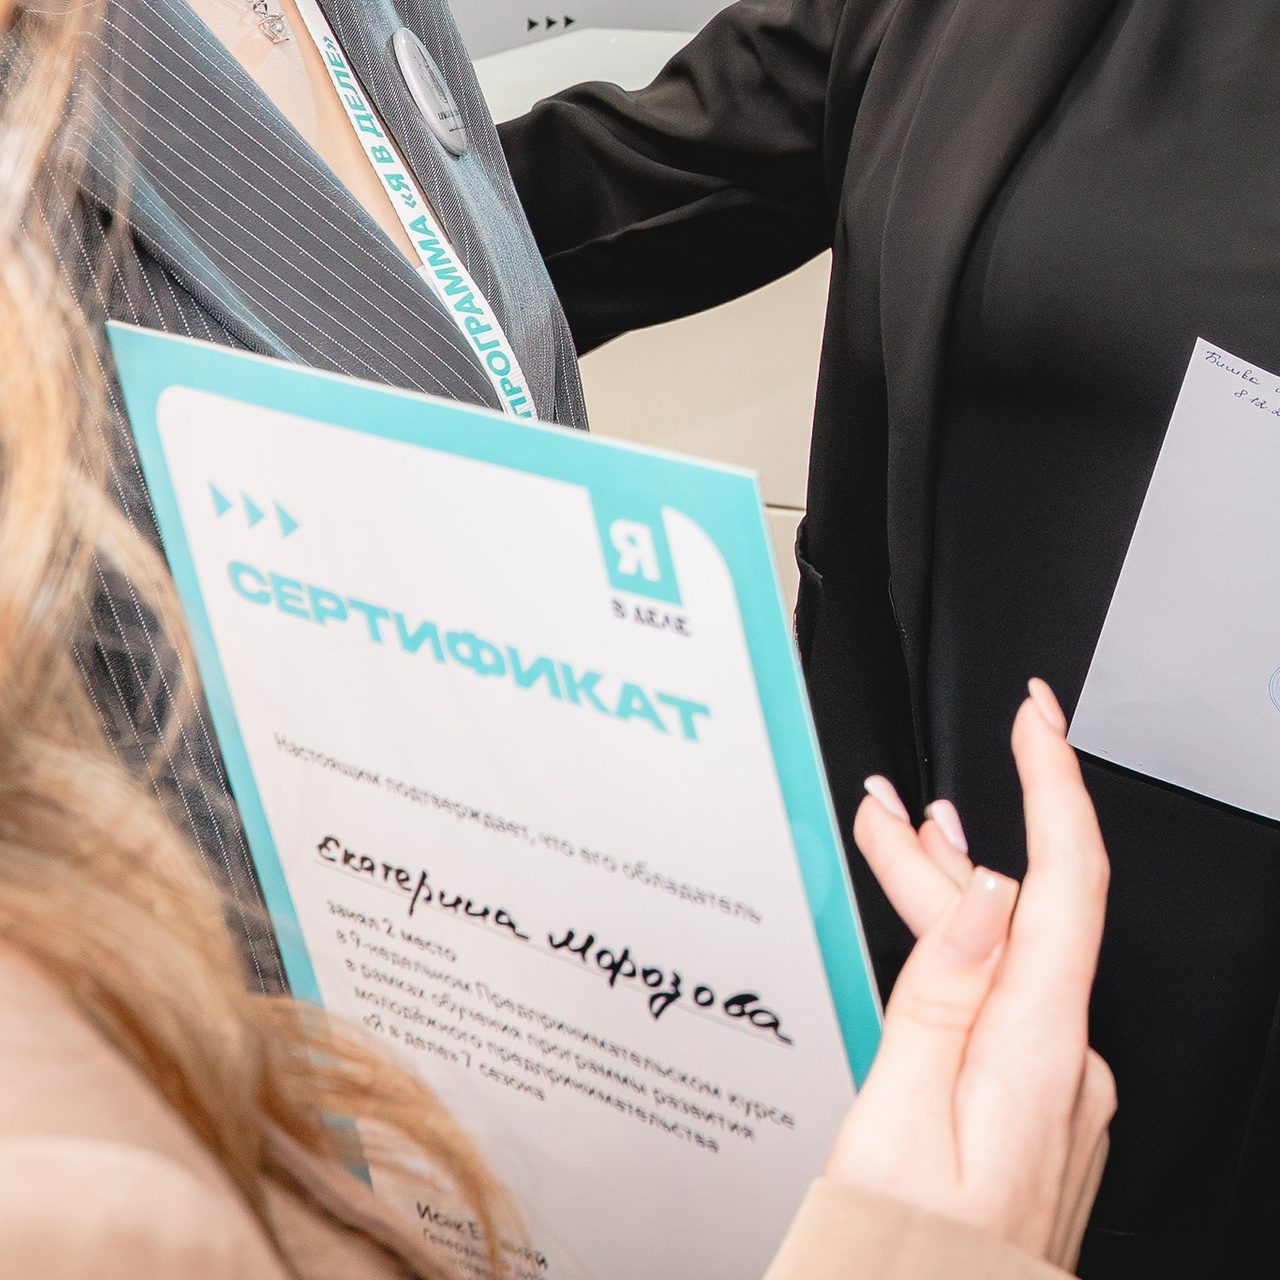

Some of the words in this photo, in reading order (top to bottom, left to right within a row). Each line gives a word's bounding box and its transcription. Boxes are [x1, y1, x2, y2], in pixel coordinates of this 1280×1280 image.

[323, 35, 383, 138] ДЕЛЕ»
[371, 145, 394, 164] В
[384, 173, 417, 208] «Я
[409, 215, 532, 418] ПРОГРАММА
[609, 519, 661, 583] Я
[227, 561, 711, 743] СЕРТИФИКАТ
[273, 731, 380, 786] Настоящим
[385, 776, 535, 844] подтверждает,
[538, 831, 575, 857] что
[580, 846, 616, 872] его
[622, 860, 762, 923] обладатель
[316, 835, 530, 939] Екатерина
[548, 927, 794, 1046] Морозова
[382, 917, 395, 938] 2
[400, 929, 457, 963] место
[336, 929, 347, 944] в
[475, 980, 721, 1099] Предпринимательском
[727, 1090, 796, 1130] курсе
[345, 958, 357, 973] в
[360, 964, 426, 1001] рамках
[431, 992, 523, 1040] обучения
[527, 1032, 647, 1096] программы
[652, 1086, 756, 1142] развития
[354, 985, 483, 1050] молодёжного
[487, 1040, 720, 1154] предпринимательства
[478, 1062, 546, 1102] сезона
